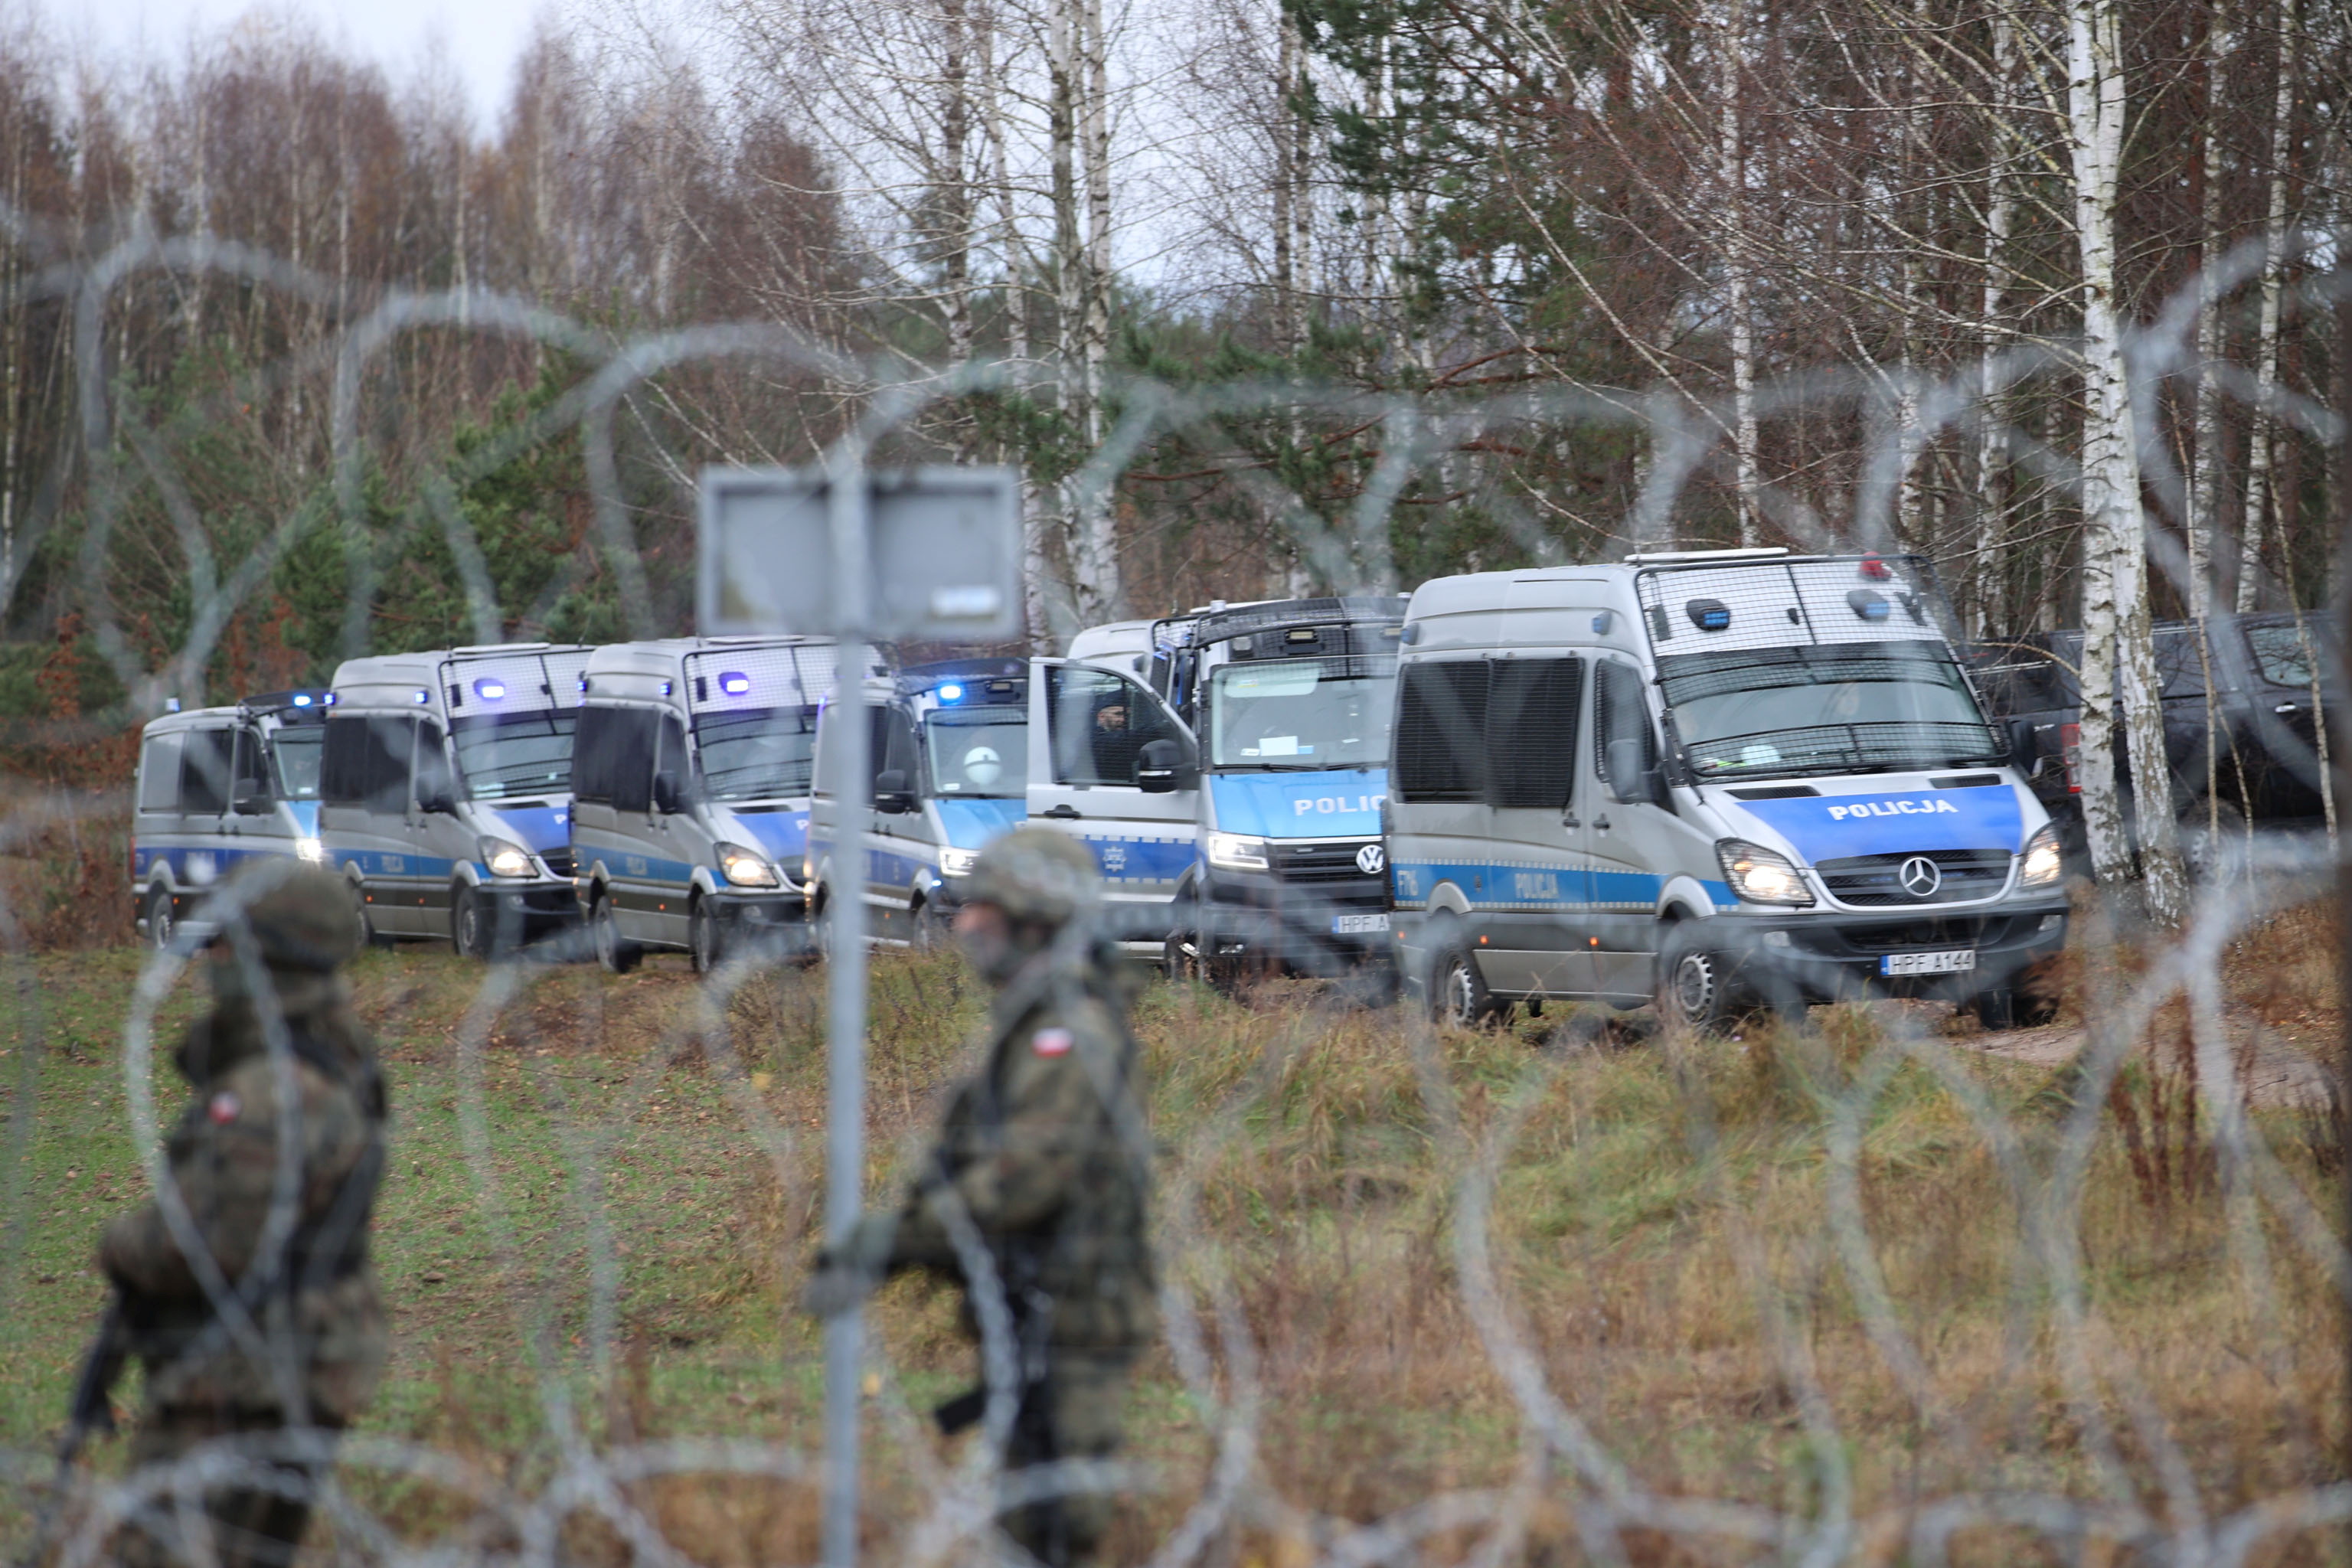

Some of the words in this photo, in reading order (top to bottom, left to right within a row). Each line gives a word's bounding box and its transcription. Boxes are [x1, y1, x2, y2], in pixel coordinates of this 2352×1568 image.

[1293, 795, 1388, 816] POLIC
[1827, 799, 1959, 821] POLICJA
[1341, 916, 1371, 932] HPF
[1891, 955, 1926, 973] HPF
[1932, 952, 1973, 971] A144
